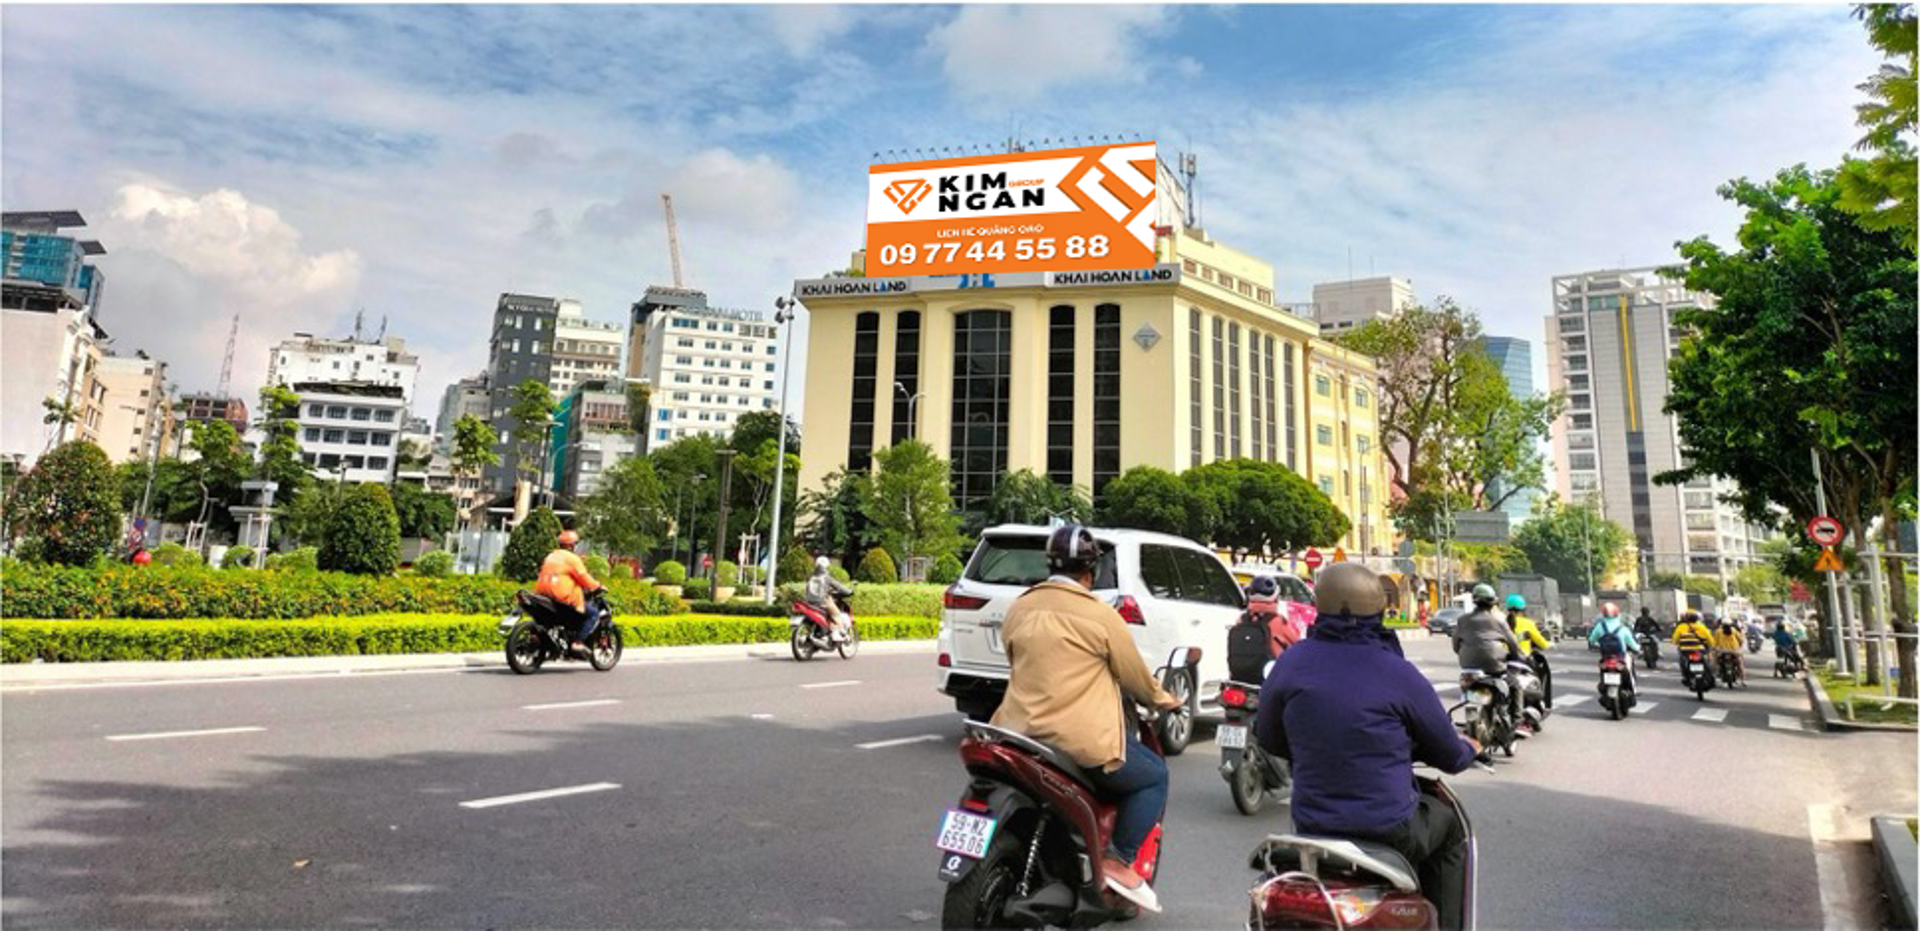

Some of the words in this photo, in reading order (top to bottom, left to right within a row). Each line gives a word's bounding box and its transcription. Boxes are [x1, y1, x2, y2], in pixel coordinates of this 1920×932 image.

[939, 171, 1007, 193] KIM
[938, 188, 1045, 212] NGAN
[880, 244, 917, 265] 09
[923, 242, 962, 263] 77
[965, 240, 1006, 262] 44
[1014, 238, 1056, 260] 55
[1065, 234, 1110, 258] 88
[1054, 272, 1088, 284] KHAI
[1136, 268, 1172, 281] LAND
[802, 284, 832, 296] KHAI
[873, 280, 906, 292] LAND
